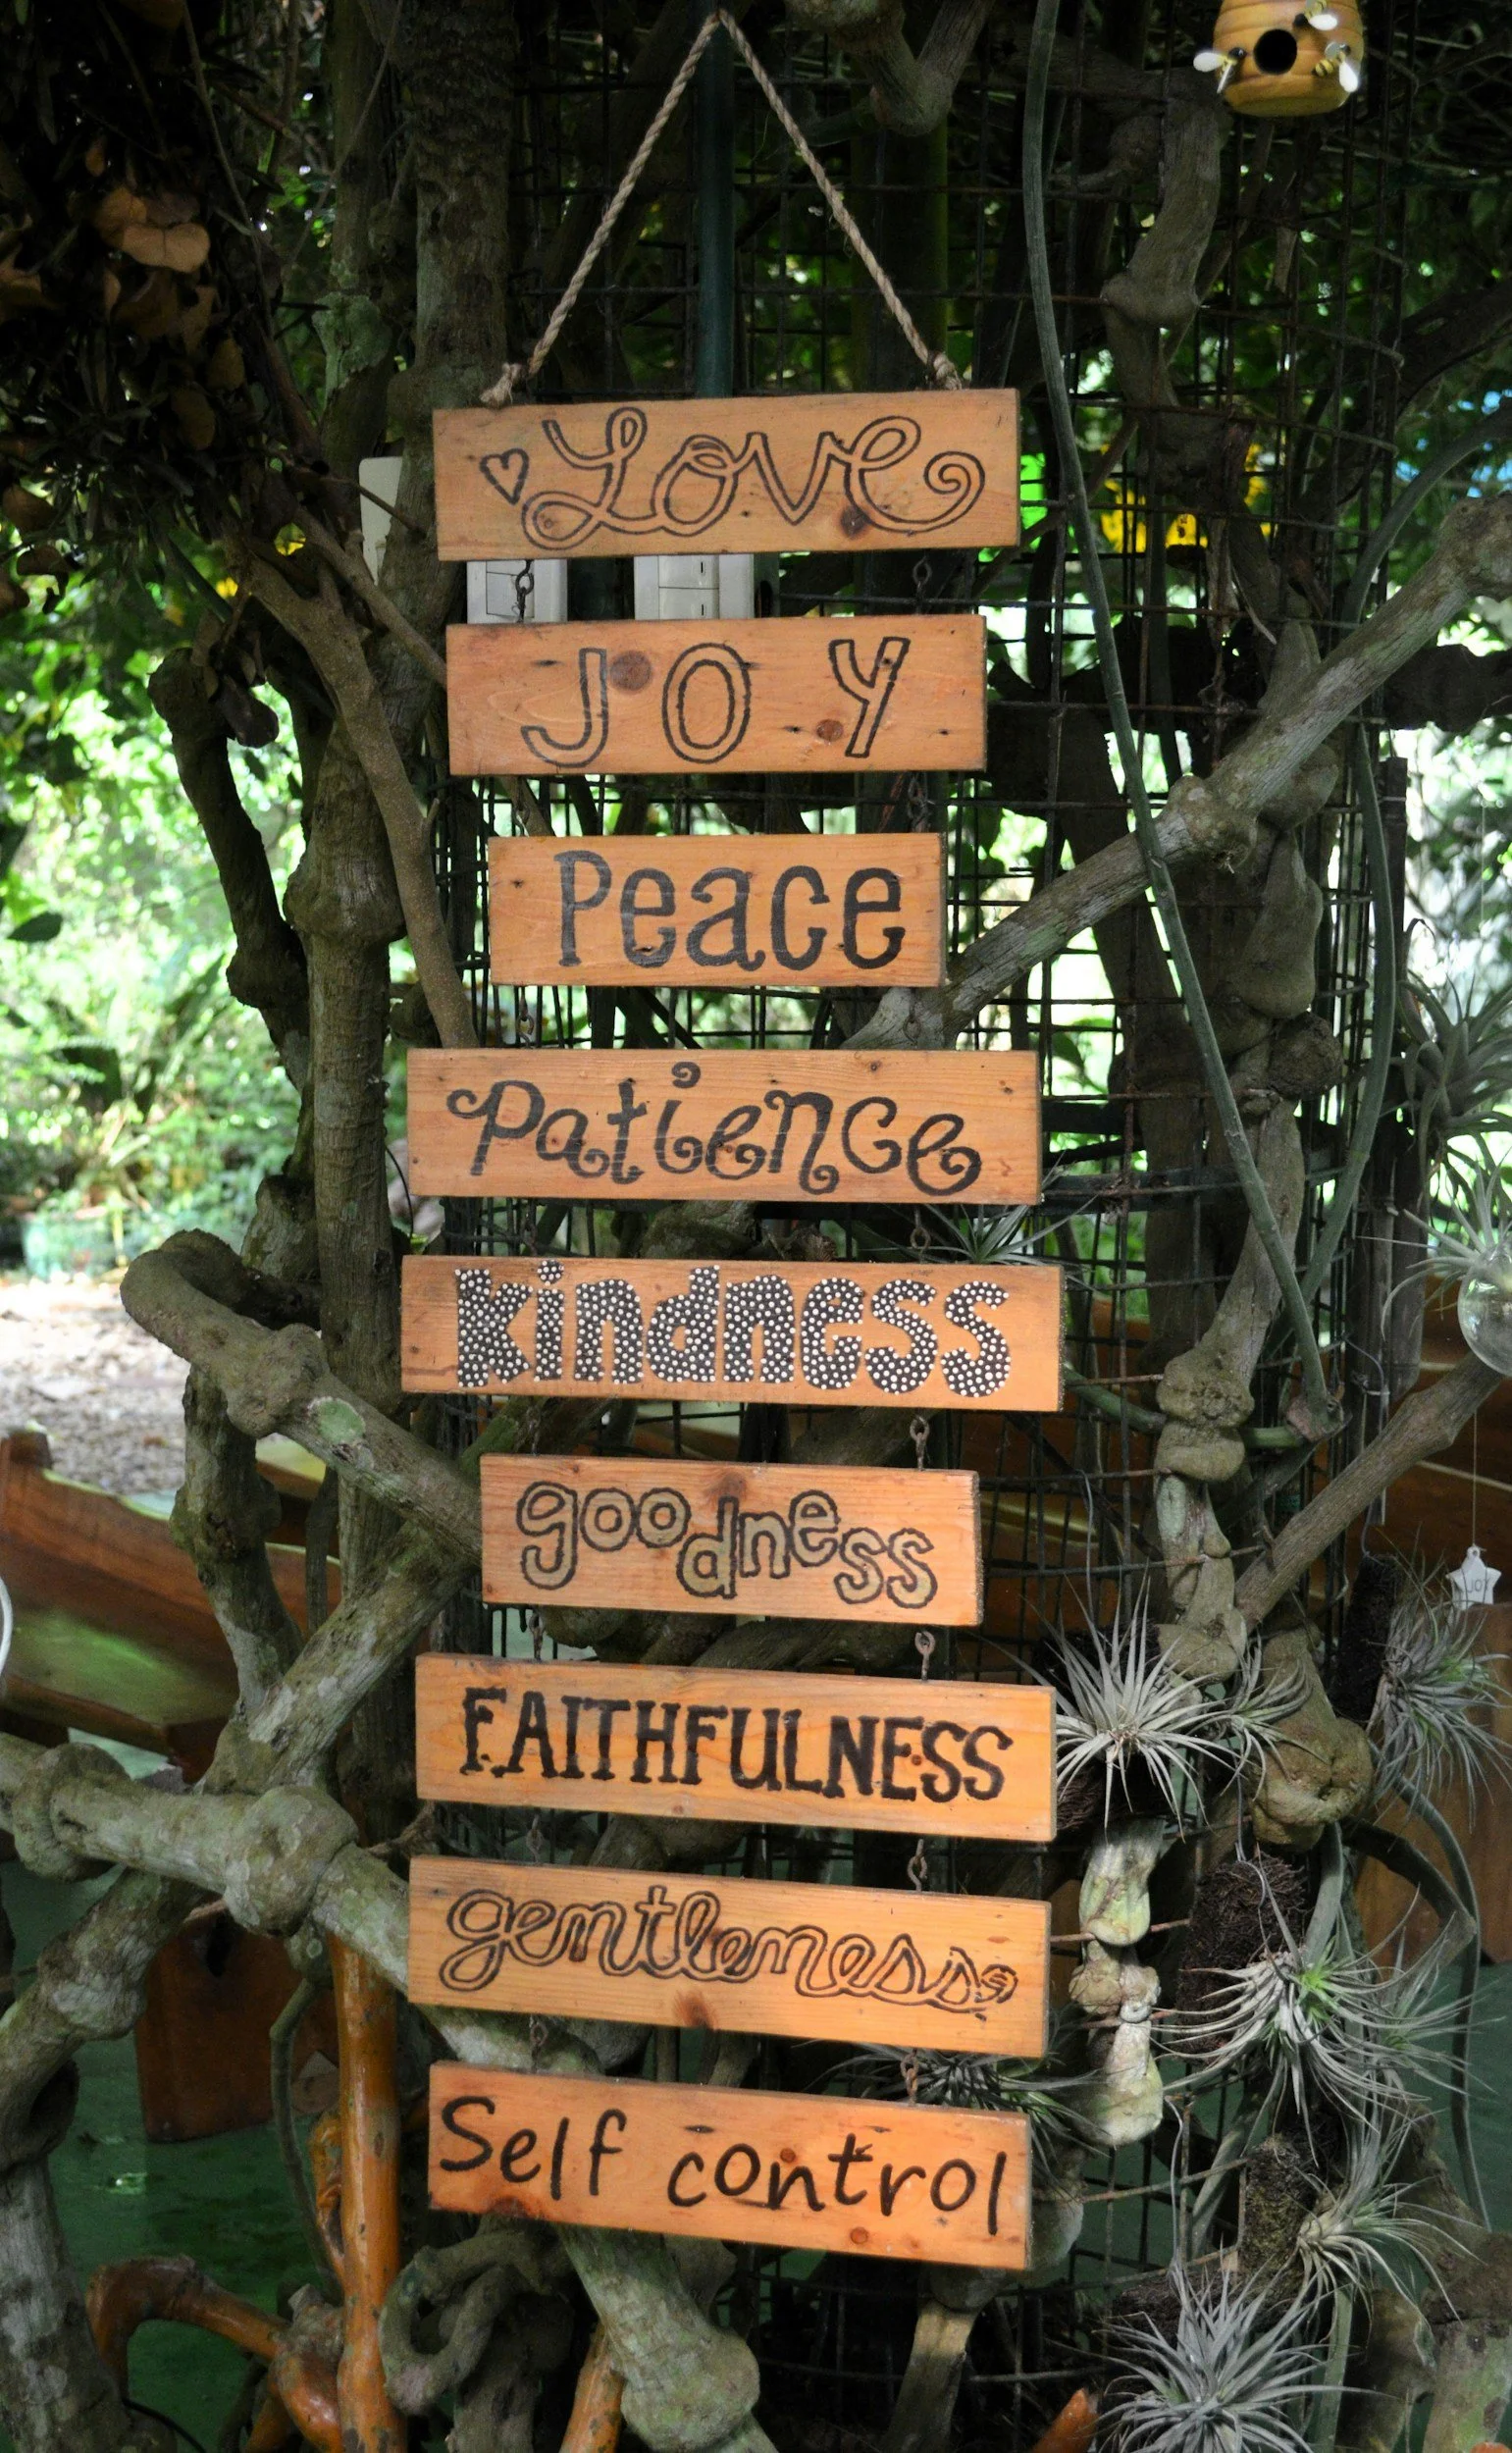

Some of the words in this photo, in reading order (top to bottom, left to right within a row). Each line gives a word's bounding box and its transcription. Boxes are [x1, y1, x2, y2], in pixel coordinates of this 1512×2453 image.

[521, 407, 986, 550] Love
[520, 636, 911, 768] JOY
[553, 850, 906, 971] Peace
[517, 1482, 939, 1608] goodness
[458, 1687, 1014, 1803] FAITHFULNESS
[440, 1886, 1019, 2019] gentleness
[439, 2096, 627, 2202] Self
[666, 2132, 1008, 2236] control
